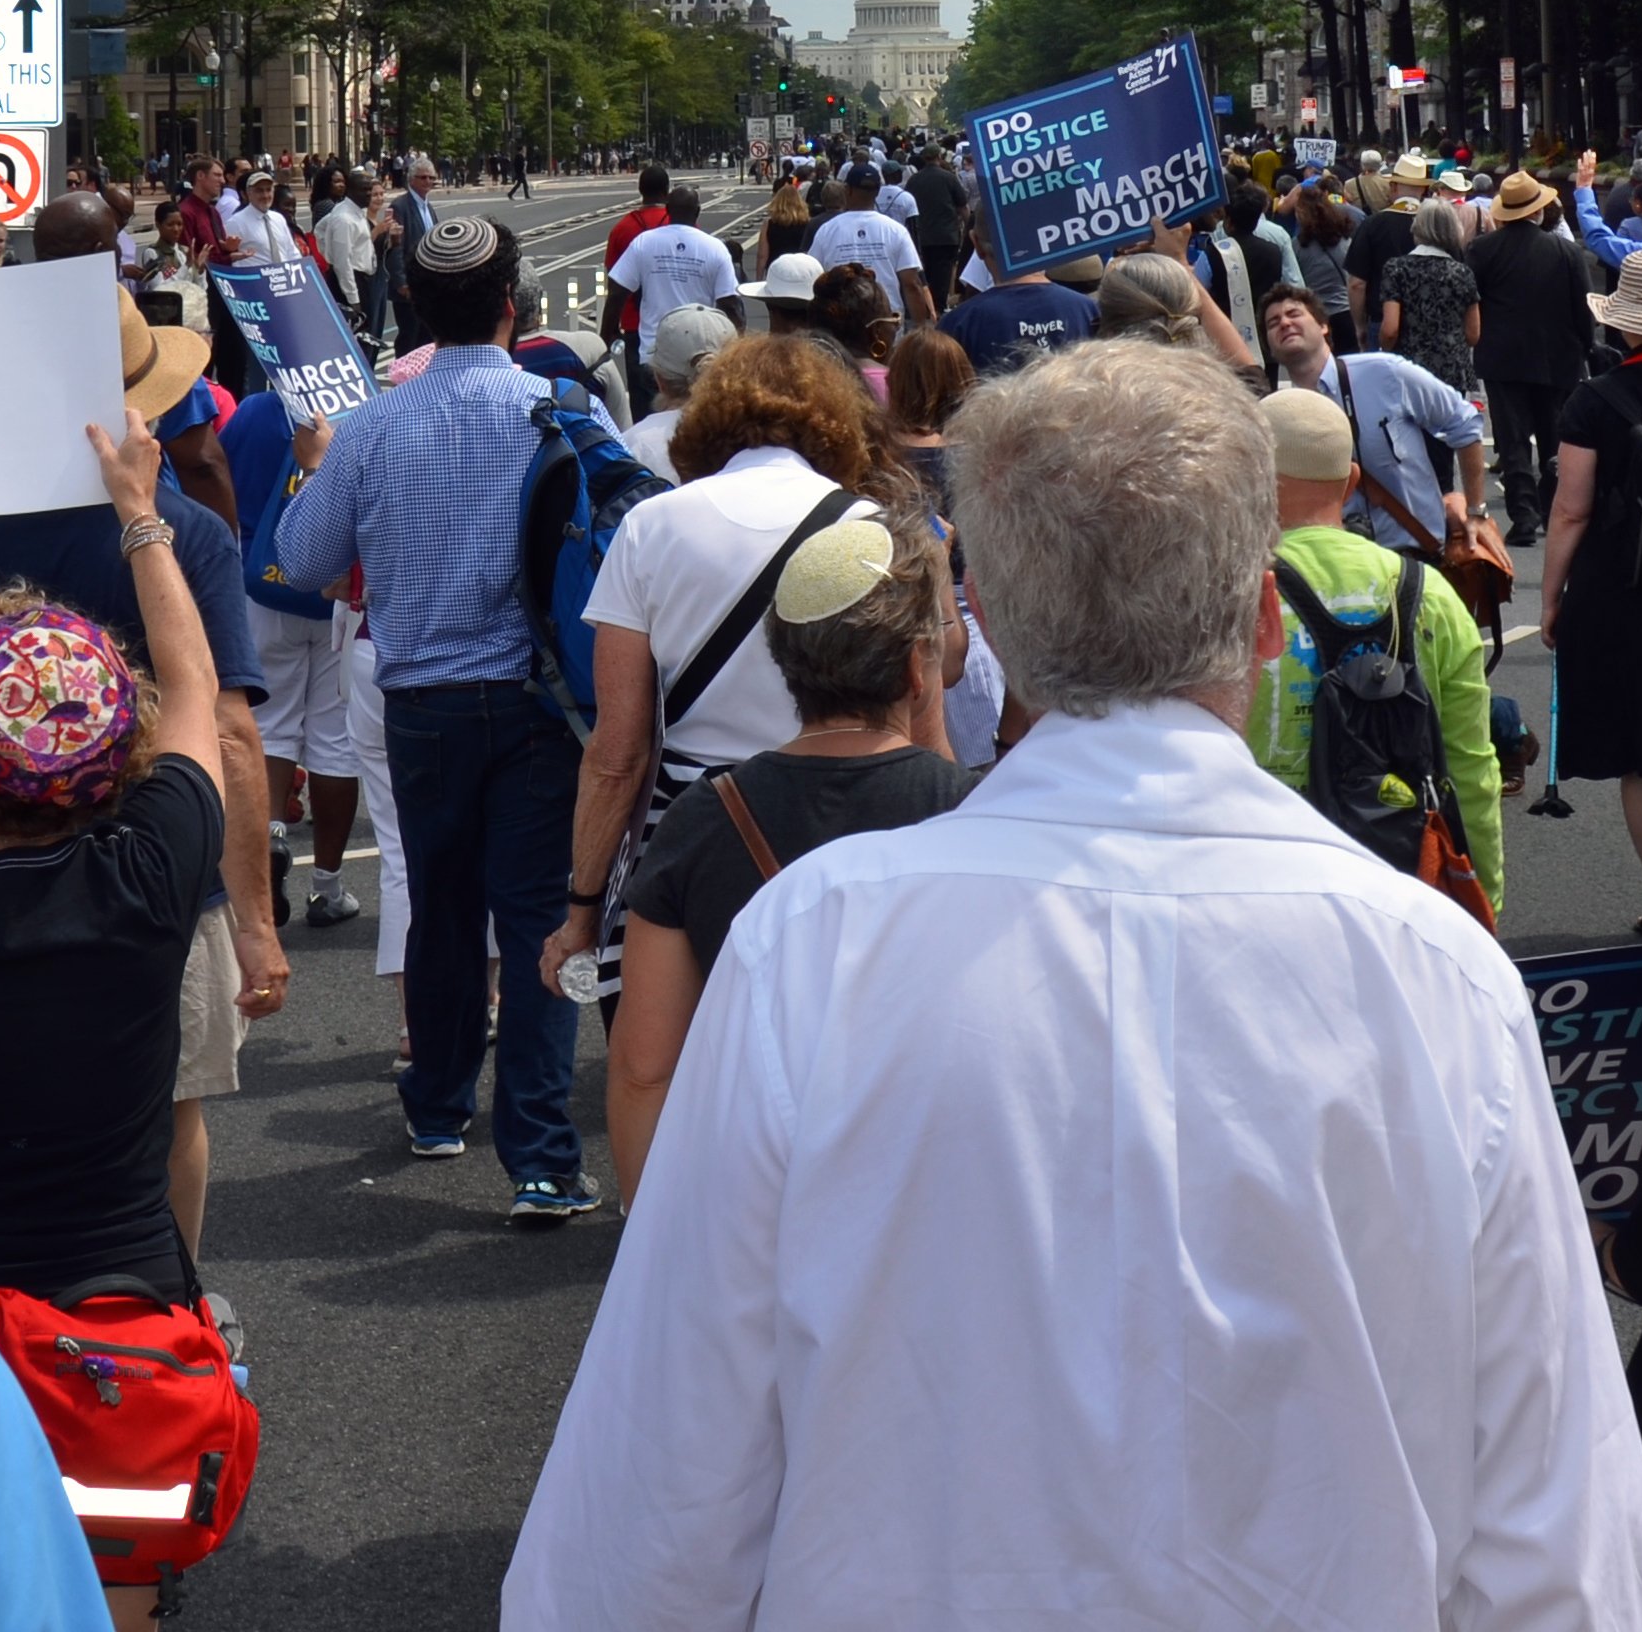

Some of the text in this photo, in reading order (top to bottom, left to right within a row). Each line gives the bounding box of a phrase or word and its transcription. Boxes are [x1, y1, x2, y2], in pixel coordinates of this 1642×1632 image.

[8, 63, 52, 85] THIS
[987, 111, 1033, 141] DO
[989, 109, 1109, 163] JUSTICE
[995, 144, 1076, 185] LOVE
[999, 158, 1103, 206] MERCY
[1075, 142, 1208, 215] MARCH
[1037, 168, 1209, 255] PROUDLY
[216, 277, 236, 298] DO
[1019, 319, 1065, 337] PRAYER
[1037, 336, 1048, 347] IS
[276, 354, 362, 393] MARCH
